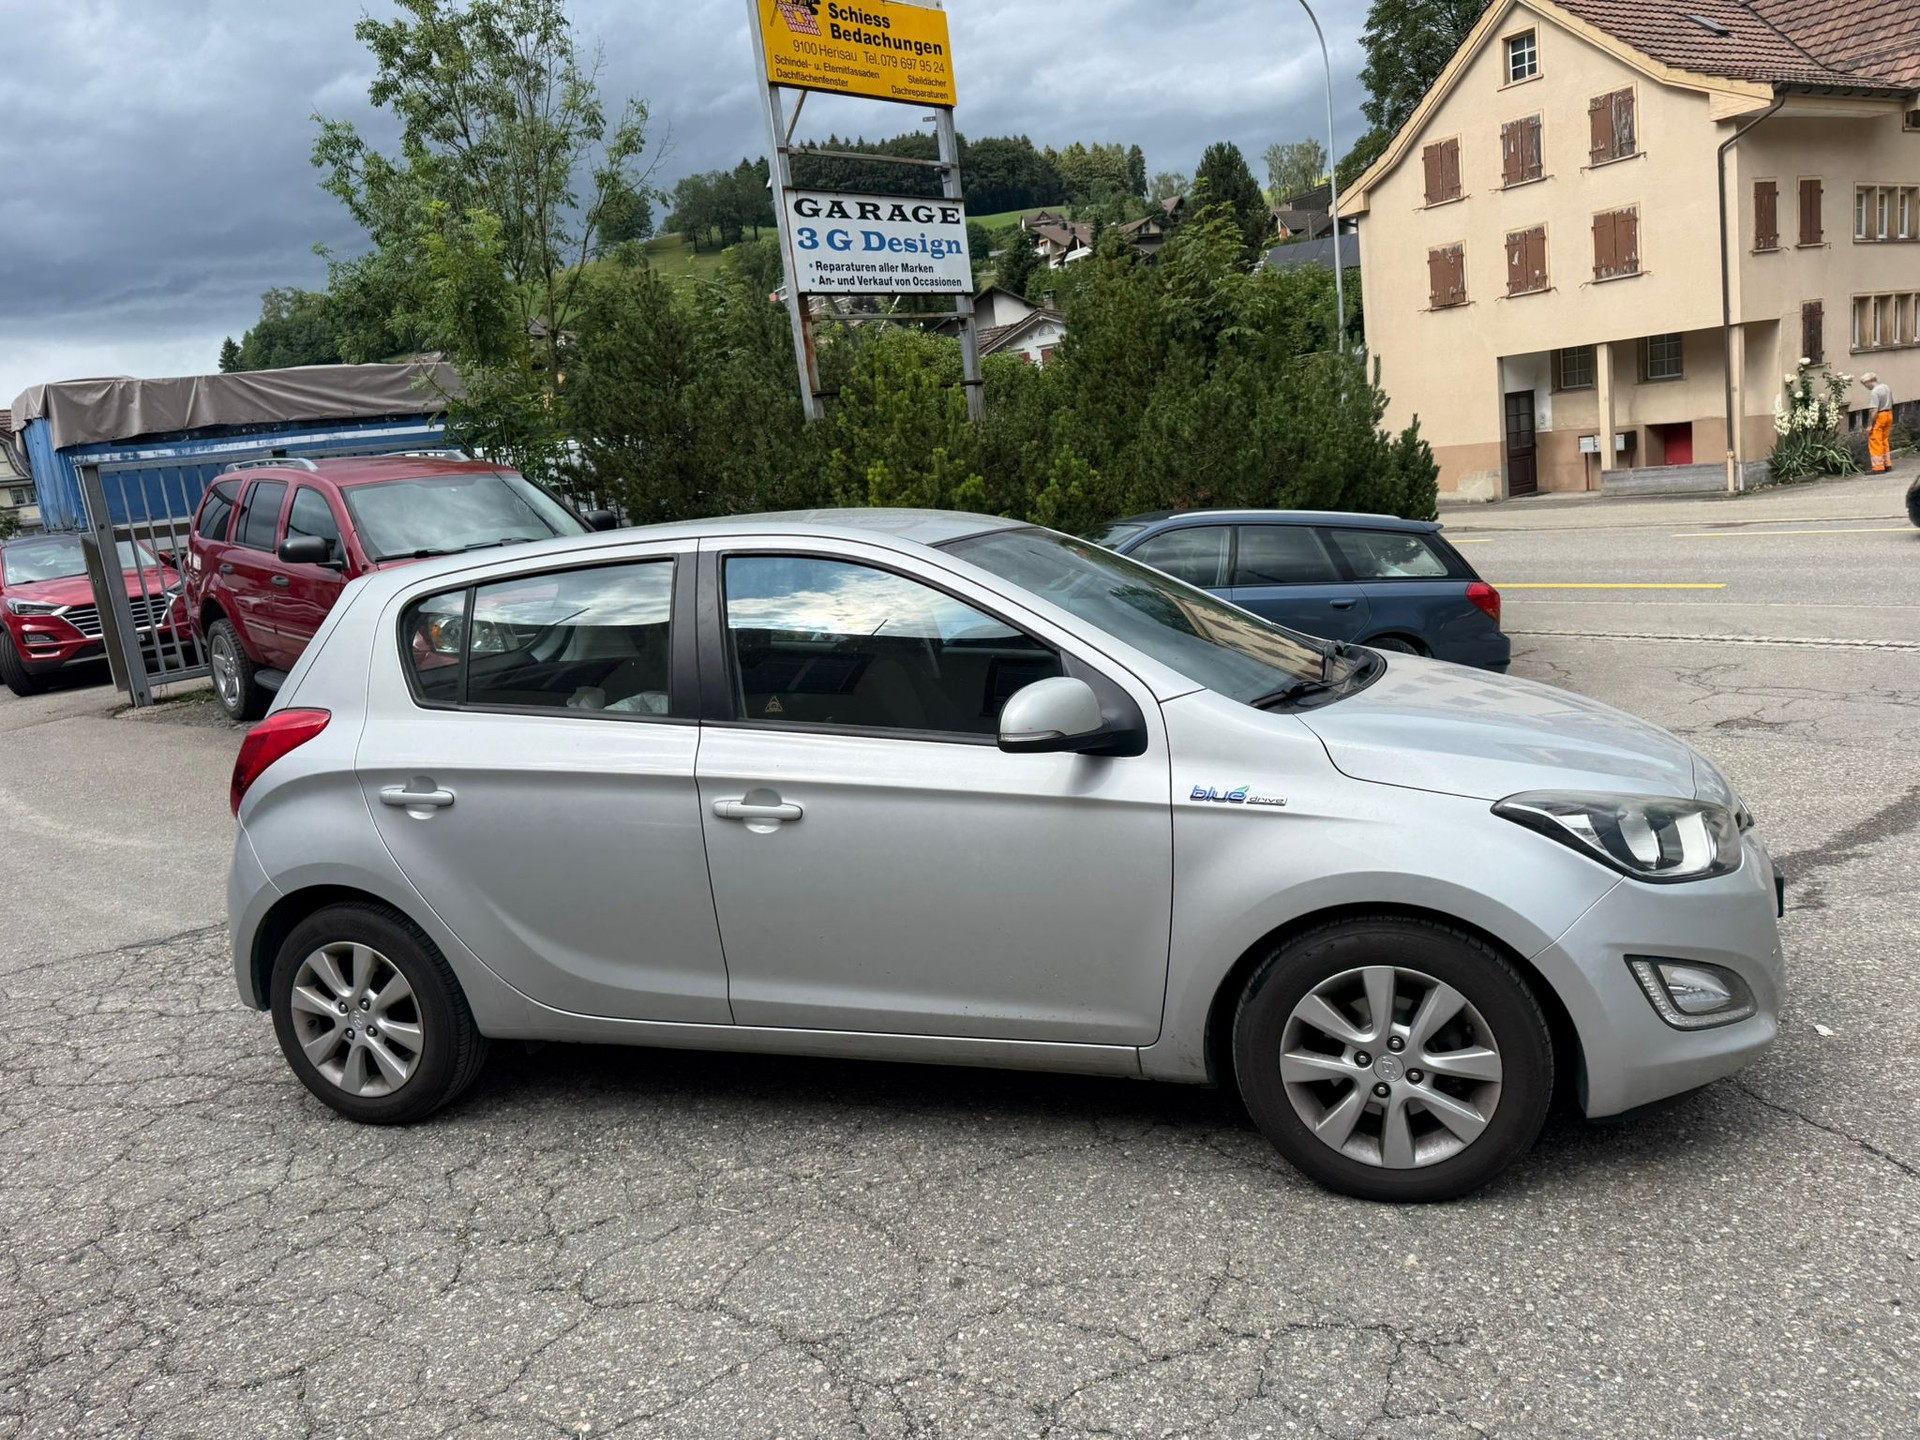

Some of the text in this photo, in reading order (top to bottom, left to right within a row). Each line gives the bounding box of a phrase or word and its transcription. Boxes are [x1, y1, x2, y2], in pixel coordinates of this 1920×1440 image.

[828, 2, 890, 29] Schiess
[830, 23, 943, 56] Bedachungen
[774, 54, 812, 69] Schindel-
[793, 39, 818, 56] 9100
[819, 44, 858, 62] Herisau
[900, 57, 917, 70] 697
[919, 60, 932, 73] 95
[933, 61, 945, 74] 24
[775, 67, 849, 88] Dachflächenfenster
[891, 85, 949, 100] Dachreparaturen
[793, 197, 961, 225] GARAGE
[860, 230, 963, 260] Design
[815, 260, 934, 274] Reparaturen aller Marken
[818, 275, 962, 287] An- und Verkauf von Occasionen
[1190, 785, 1288, 806] blue drive
